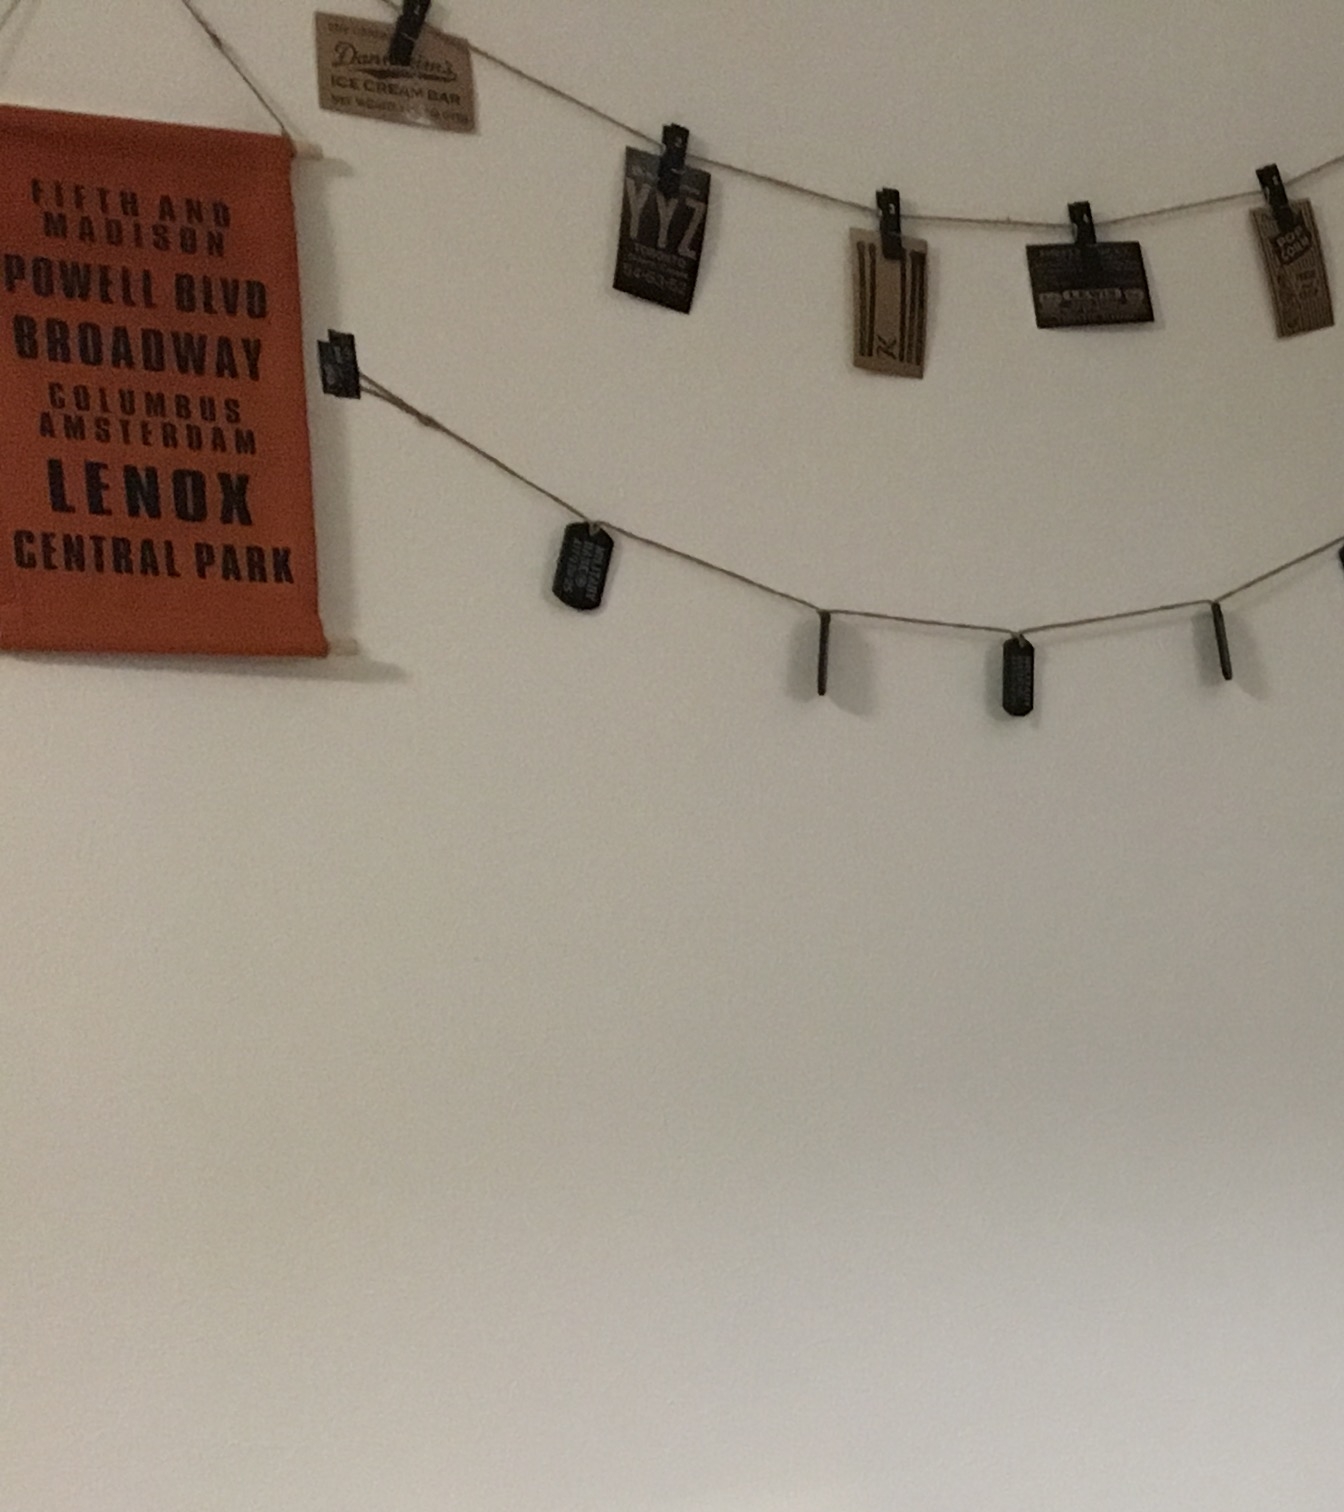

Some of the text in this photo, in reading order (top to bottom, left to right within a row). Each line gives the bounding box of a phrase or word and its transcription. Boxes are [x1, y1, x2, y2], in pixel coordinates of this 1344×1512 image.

[31, 178, 230, 227] FIFTH AND
[44, 211, 224, 257] MADISON
[4, 254, 267, 319] POWELL BLVD
[13, 314, 261, 382] BROADWAY
[48, 382, 241, 423] COLUMBUS
[39, 412, 256, 455] AMSTERDAM
[47, 458, 252, 525] LENOX
[13, 529, 294, 584] CENTRAL PARK
